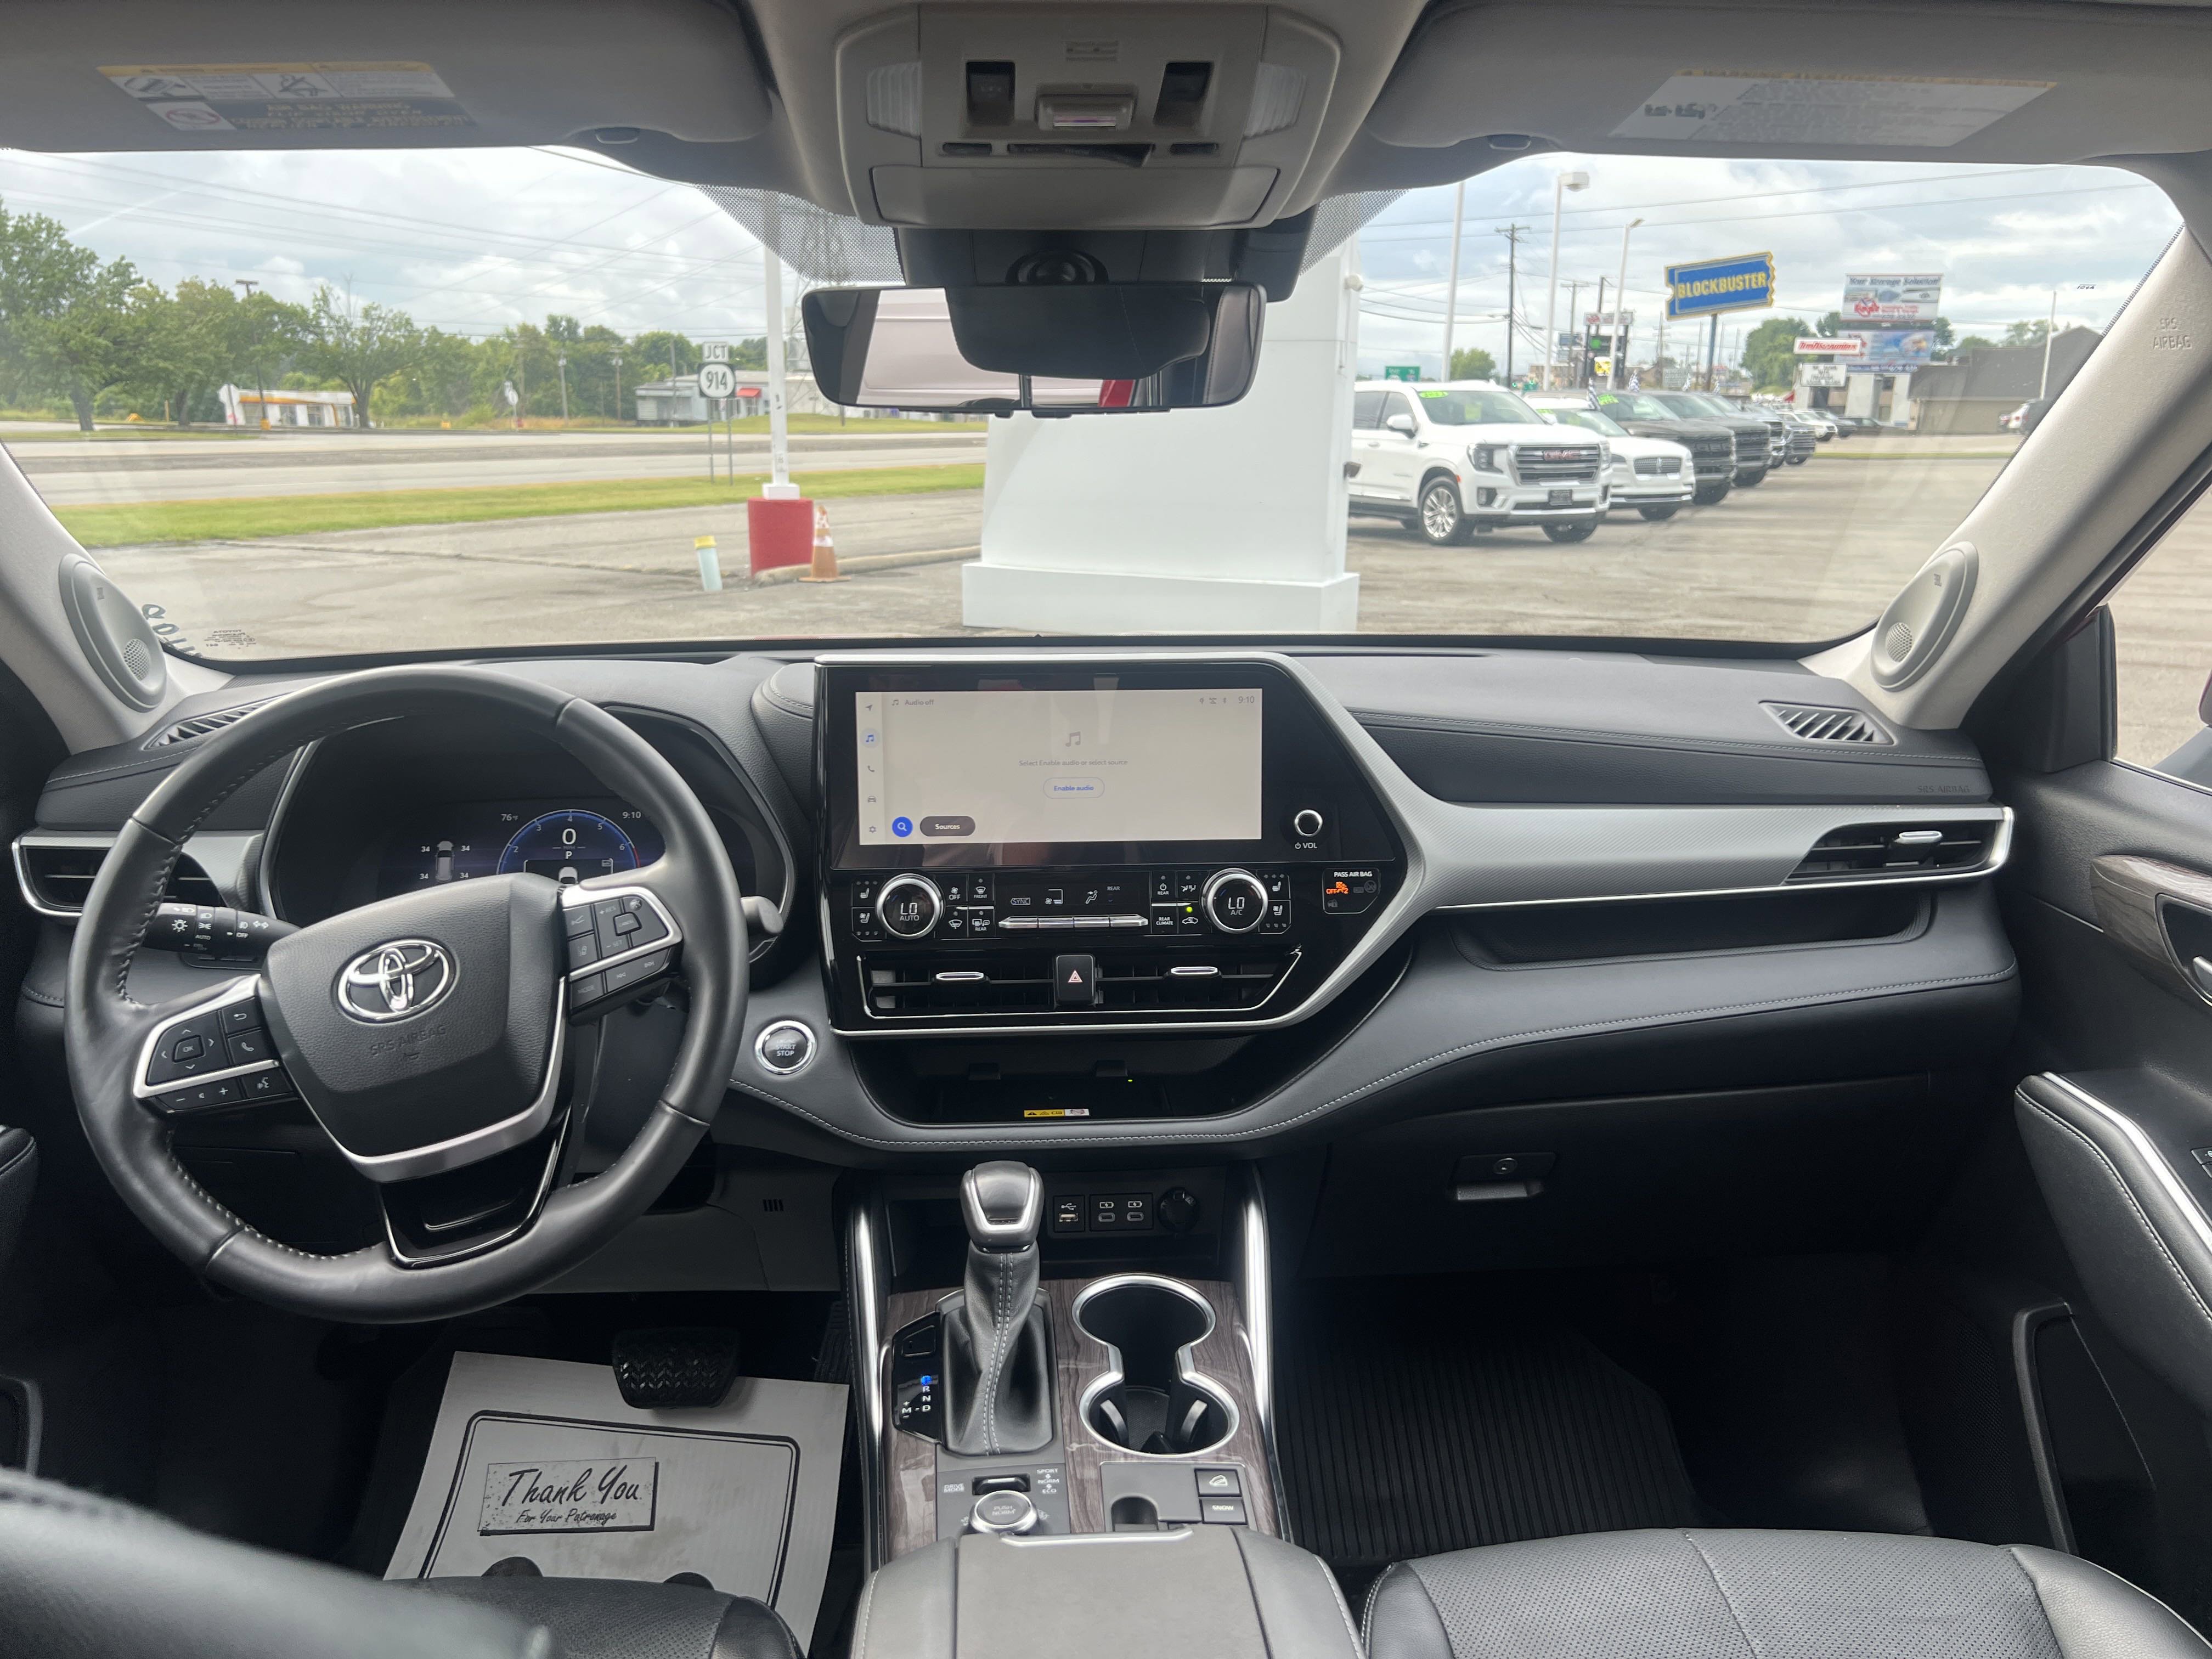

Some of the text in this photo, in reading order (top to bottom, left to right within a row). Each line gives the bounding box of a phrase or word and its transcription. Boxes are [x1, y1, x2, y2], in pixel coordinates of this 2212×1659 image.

[1677, 272, 1767, 298] BLOCKBUSTER
[705, 345, 727, 359] JCT
[706, 371, 727, 390] 914
[1544, 449, 1581, 460] GMC
[565, 851, 573, 859] P
[900, 902, 918, 915] LO
[1228, 896, 1245, 909] LO
[502, 1464, 640, 1506] Thank You
[516, 1508, 617, 1526] For Your Patronage
